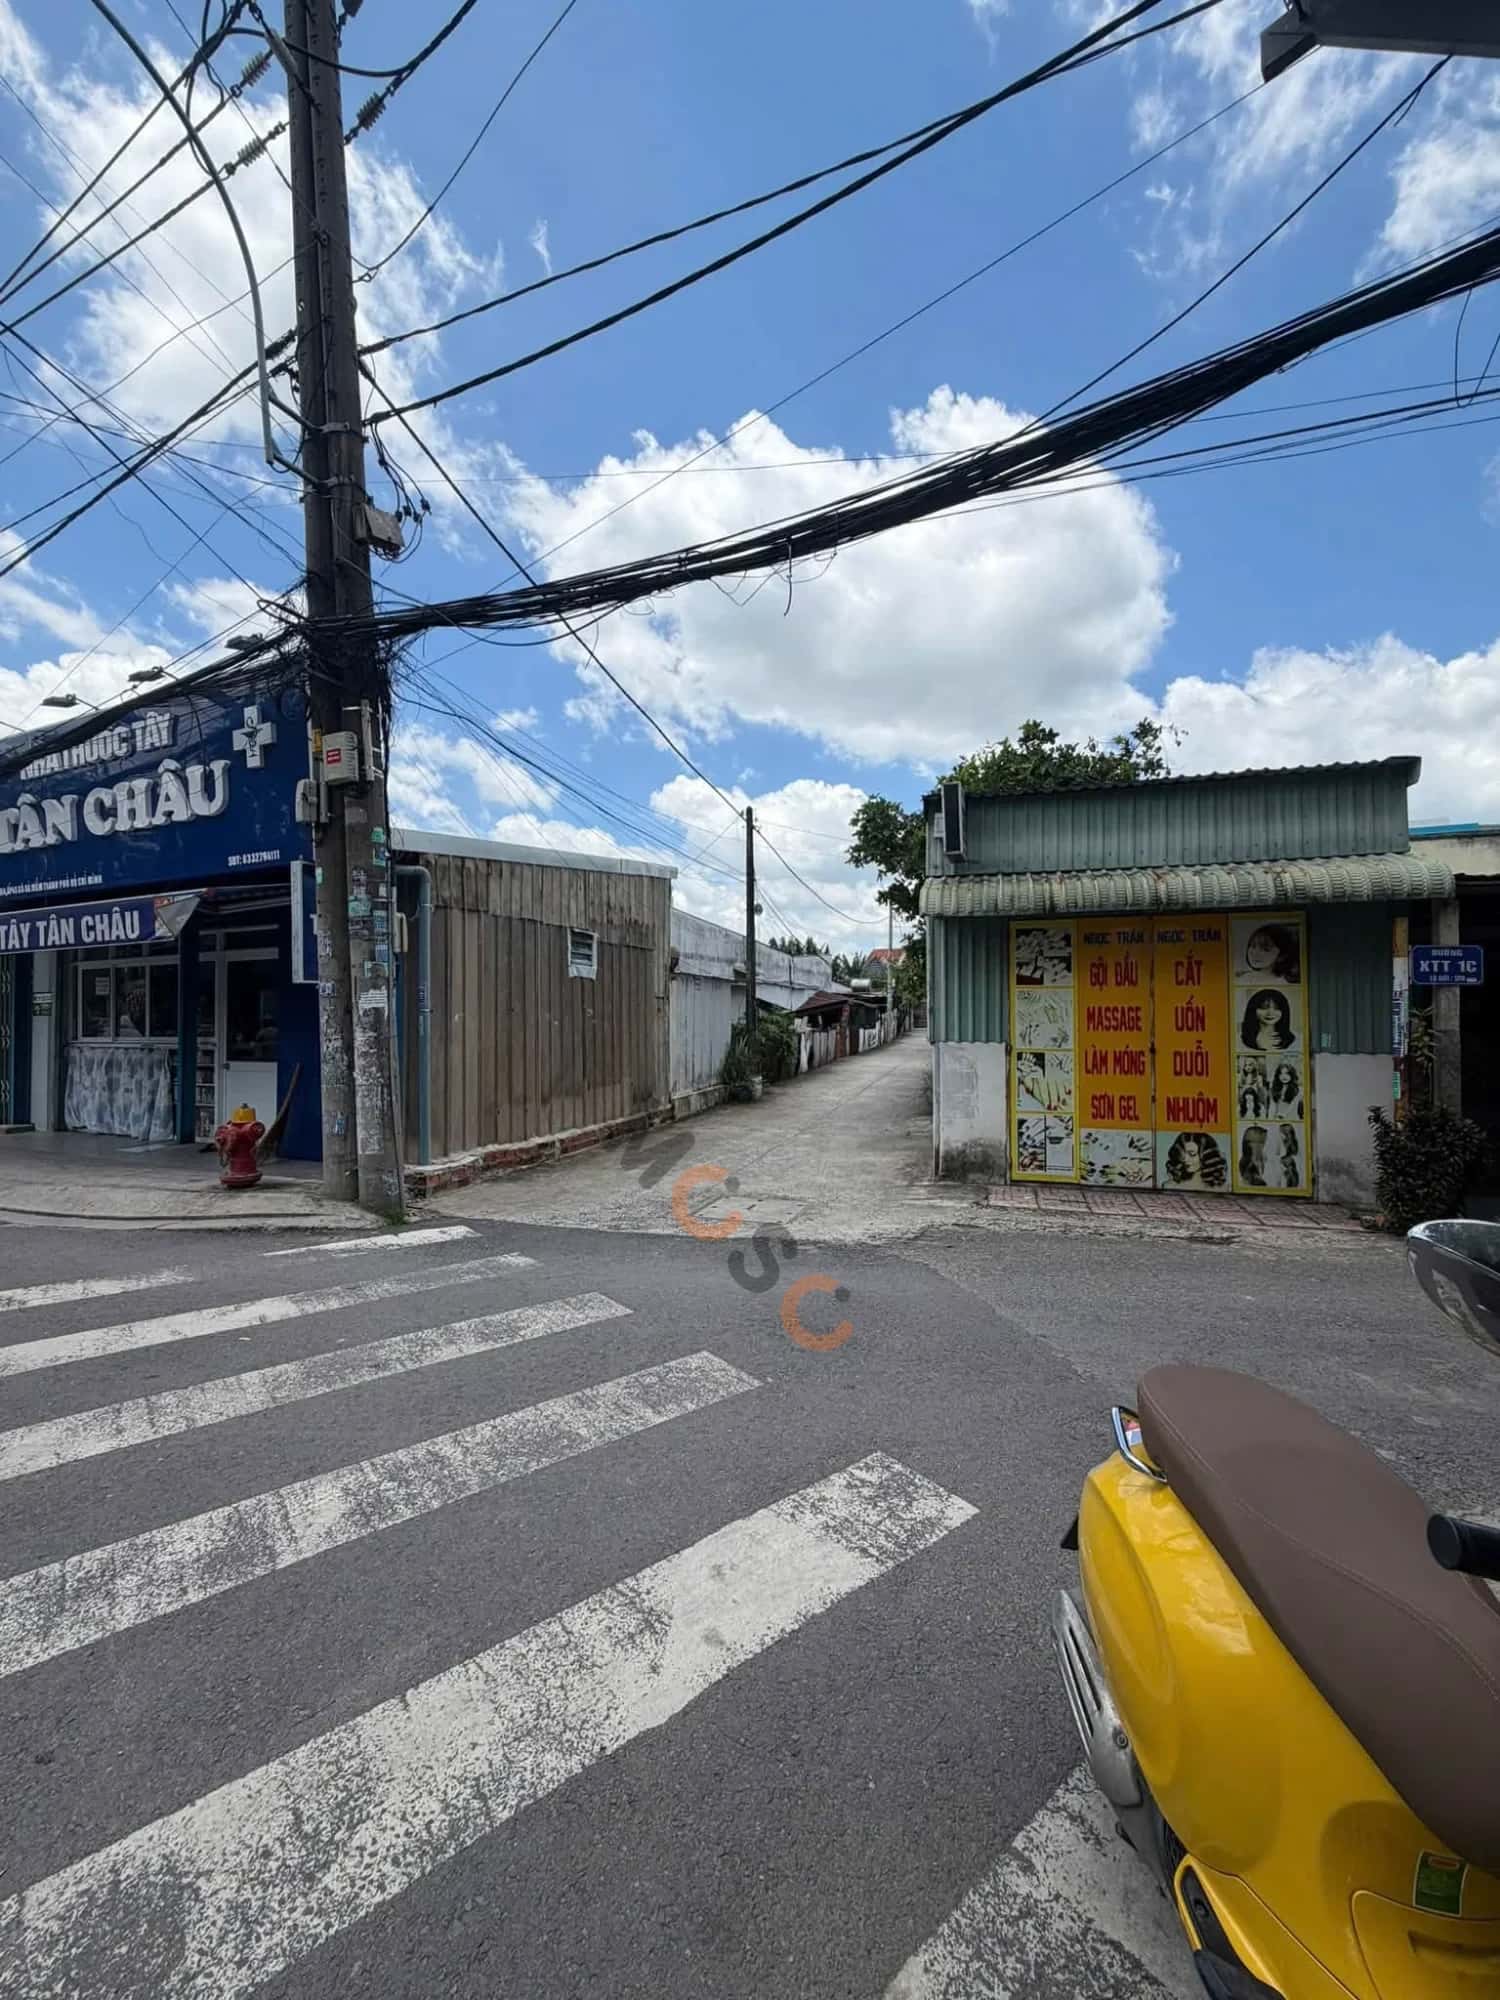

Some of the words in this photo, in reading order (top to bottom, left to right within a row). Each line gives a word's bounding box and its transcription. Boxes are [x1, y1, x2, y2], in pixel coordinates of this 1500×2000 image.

[132, 711, 172, 751] TÂY
[0, 793, 79, 854] TÂN
[83, 758, 232, 837] CHÂU
[0, 918, 31, 950] TÂY
[36, 913, 75, 947] TÂN
[80, 906, 140, 944] CHÂU
[1089, 954, 1109, 992] GỘI
[1174, 948, 1204, 987] CẮT
[1458, 960, 1477, 973] 1C
[1086, 1006, 1143, 1033] MASSAGE
[1174, 995, 1206, 1033] UỐN
[1084, 1044, 1109, 1076] LÀM
[1113, 1044, 1146, 1076] MÓNG
[1173, 1039, 1210, 1078] DUỖI
[1090, 1092, 1115, 1121] SƠN
[1118, 1094, 1140, 1121] GEL
[1166, 1090, 1219, 1129] NHUỘM
